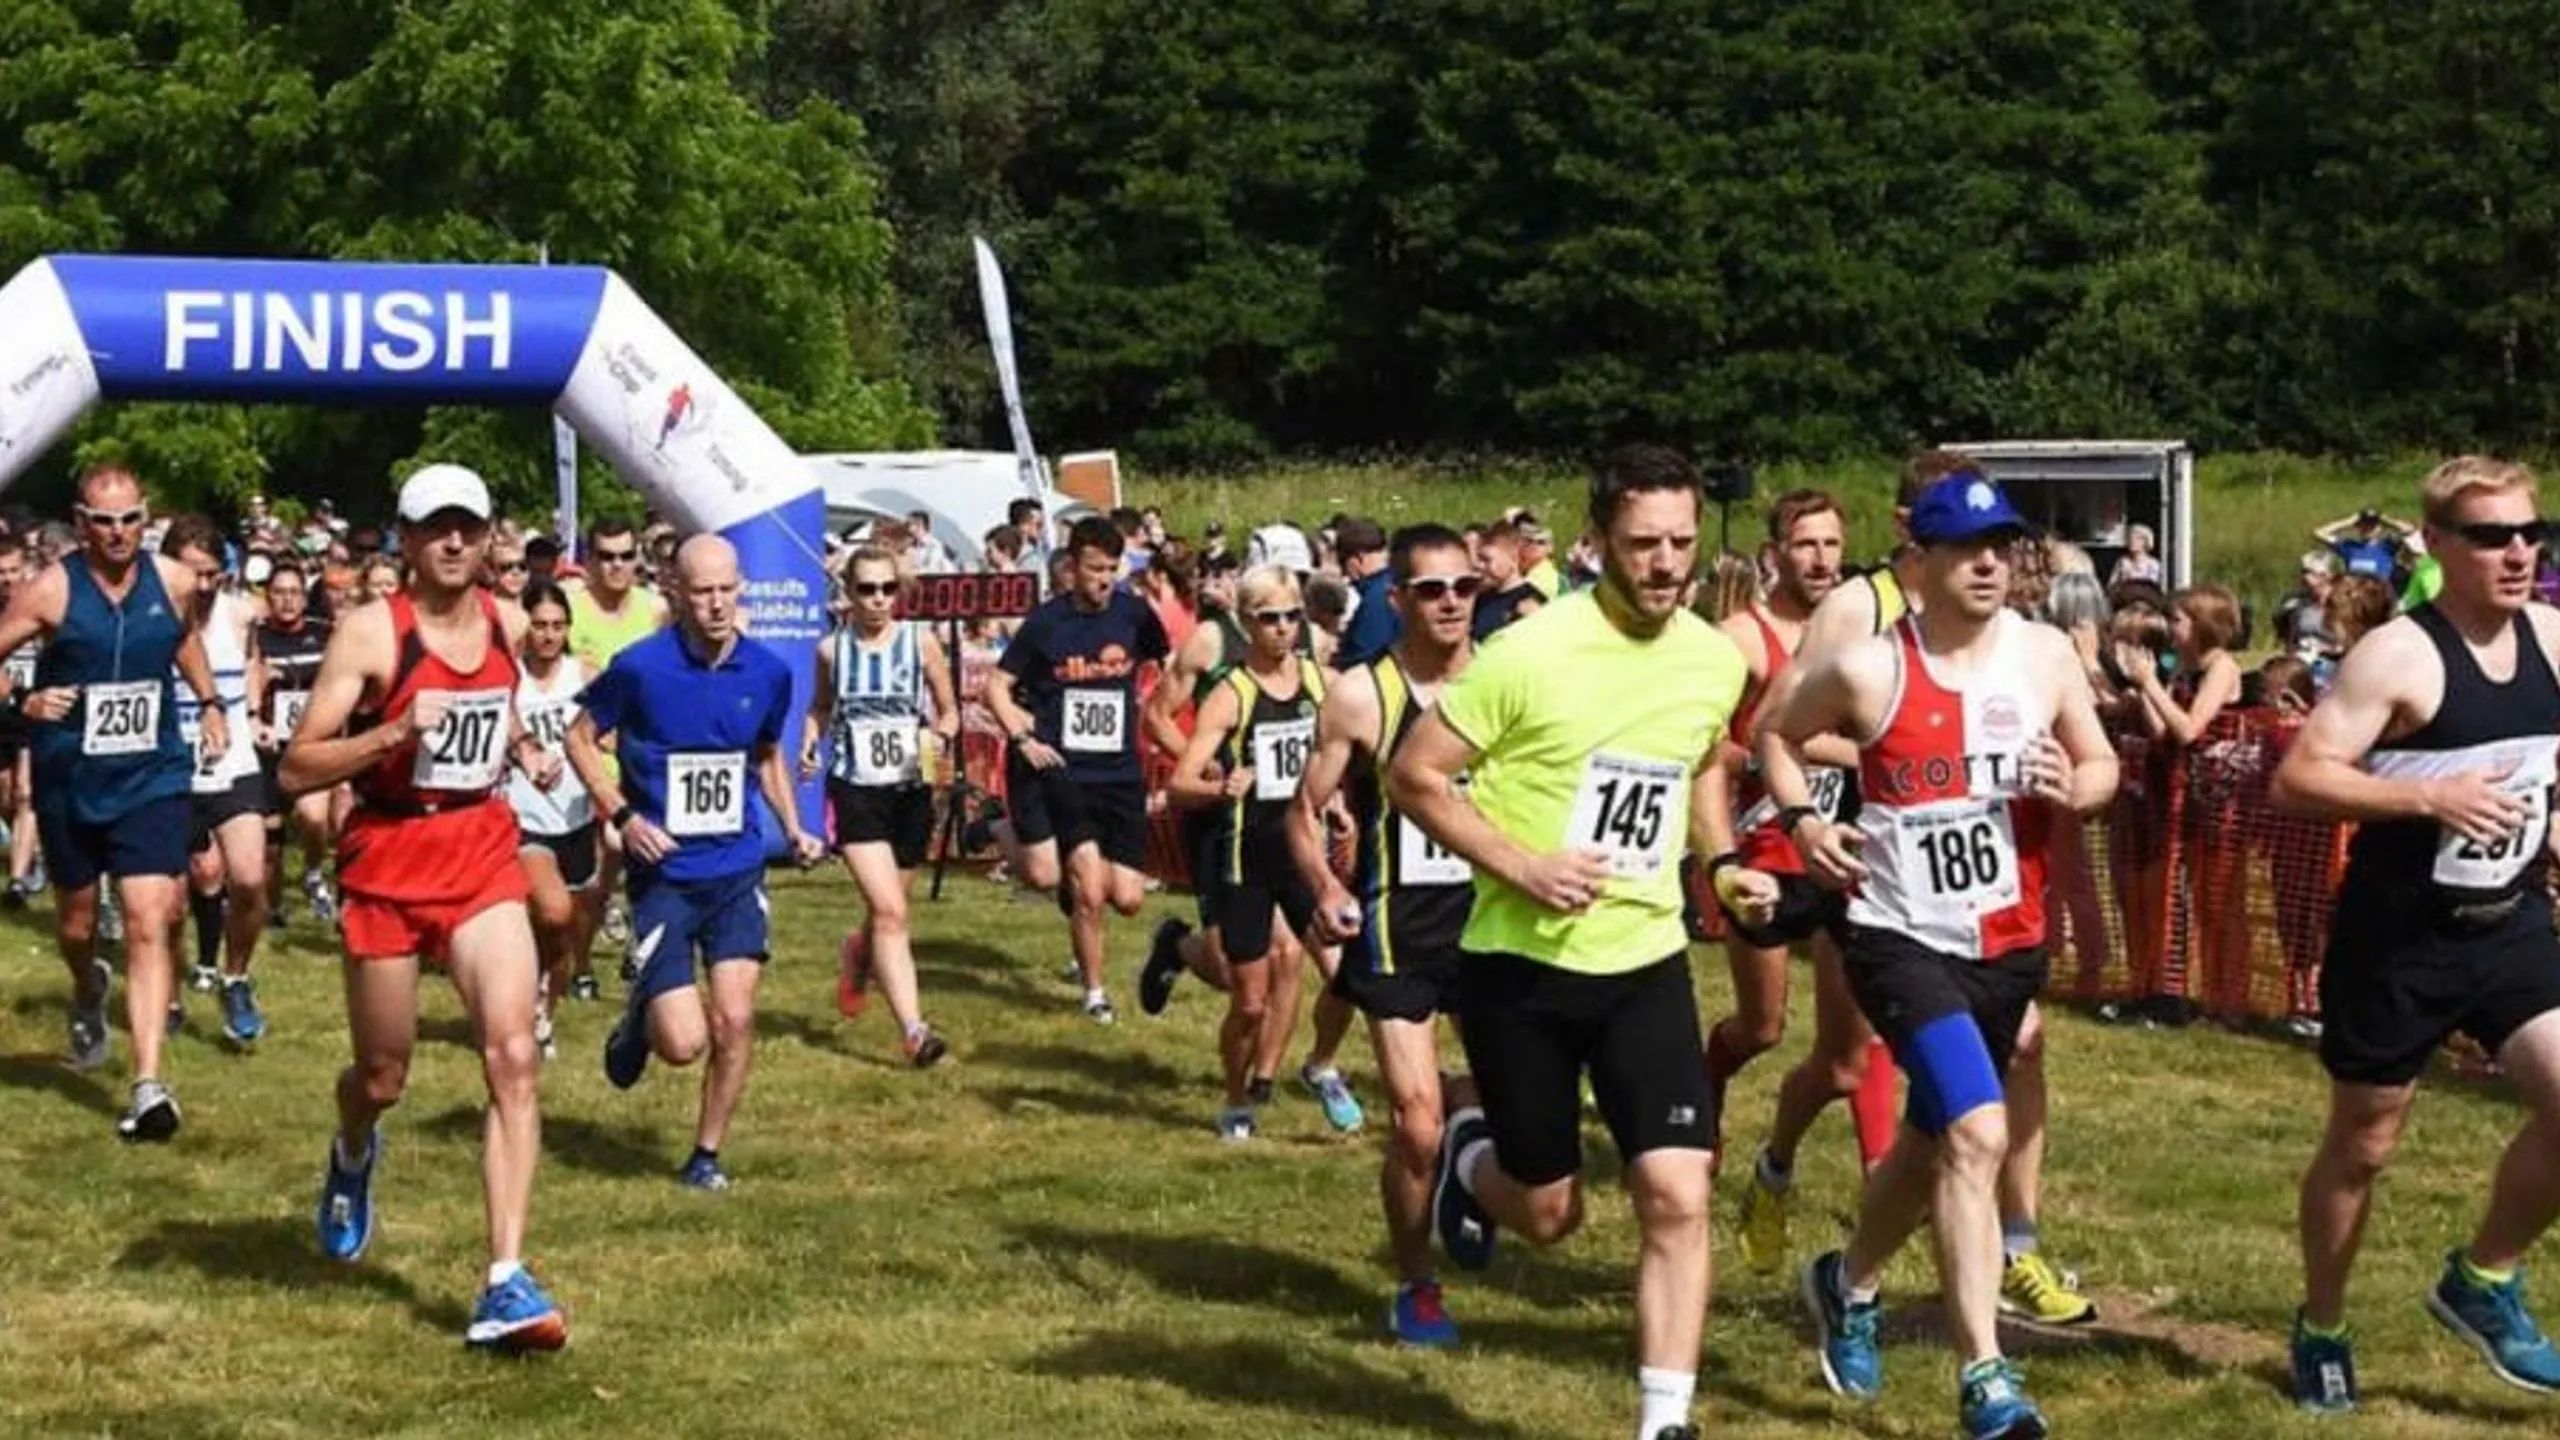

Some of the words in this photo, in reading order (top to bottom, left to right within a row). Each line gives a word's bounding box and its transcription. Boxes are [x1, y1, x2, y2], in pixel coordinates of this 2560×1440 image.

[164, 290, 513, 371] FINISH
[96, 695, 150, 737] 230
[432, 709, 499, 765] 207
[1071, 702, 1117, 736] 308
[871, 731, 904, 769] 86
[679, 768, 731, 815] 166
[1592, 779, 1667, 851] 145
[1917, 822, 1999, 894] 186
